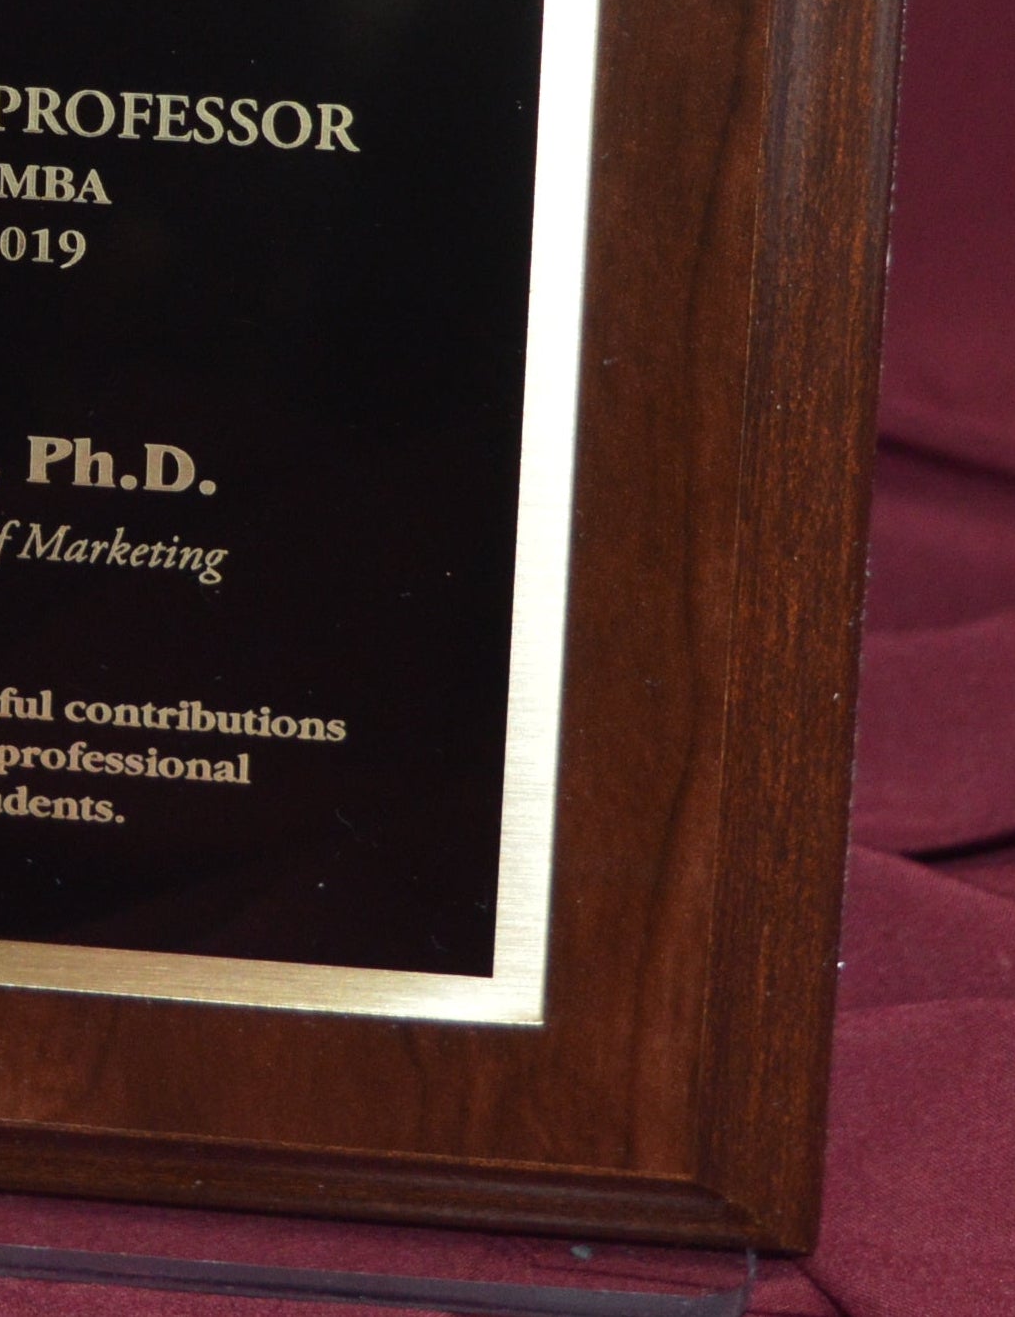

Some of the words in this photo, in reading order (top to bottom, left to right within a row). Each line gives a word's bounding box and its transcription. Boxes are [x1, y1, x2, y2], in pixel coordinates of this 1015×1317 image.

[27, 436, 216, 495] Ph.D.
[17, 523, 228, 584] Marketing
[65, 701, 346, 741] contributions
